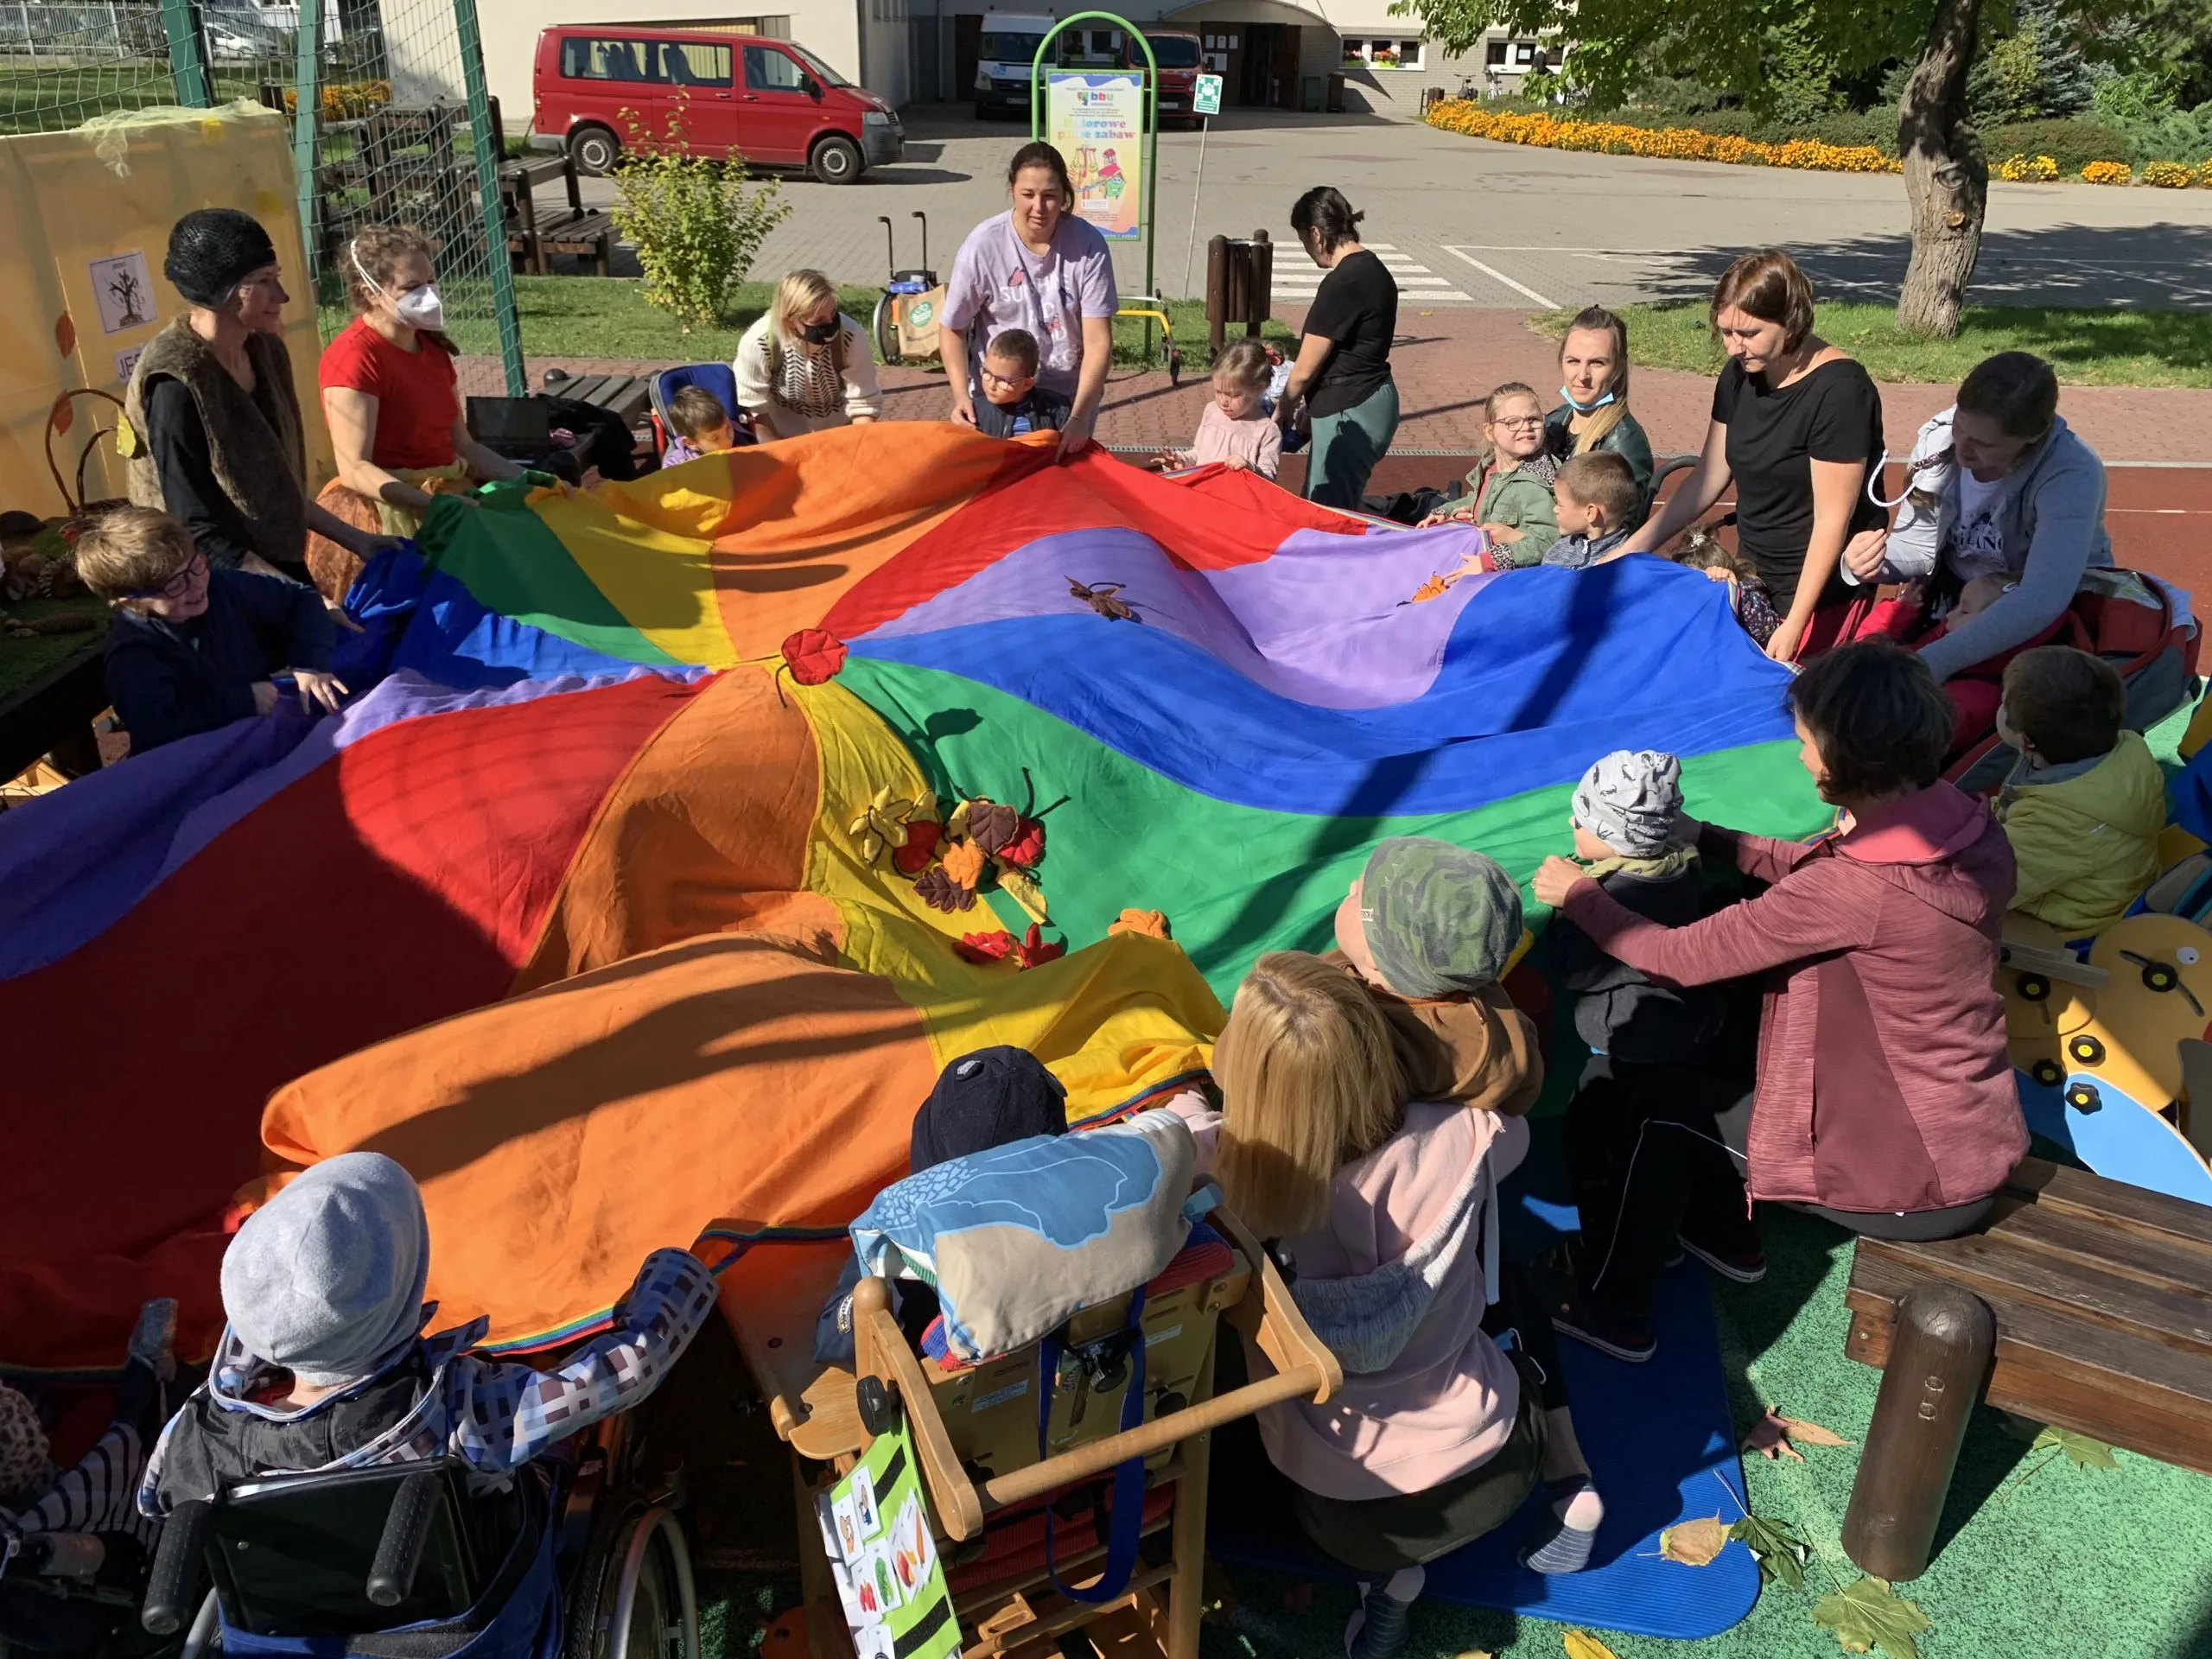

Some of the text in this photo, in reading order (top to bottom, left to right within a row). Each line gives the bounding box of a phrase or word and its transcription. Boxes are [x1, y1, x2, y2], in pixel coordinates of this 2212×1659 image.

[1090, 92, 1114, 101] bbu
[1064, 118, 1127, 129] lorowe
[1058, 130, 1135, 140] plae zabaw
